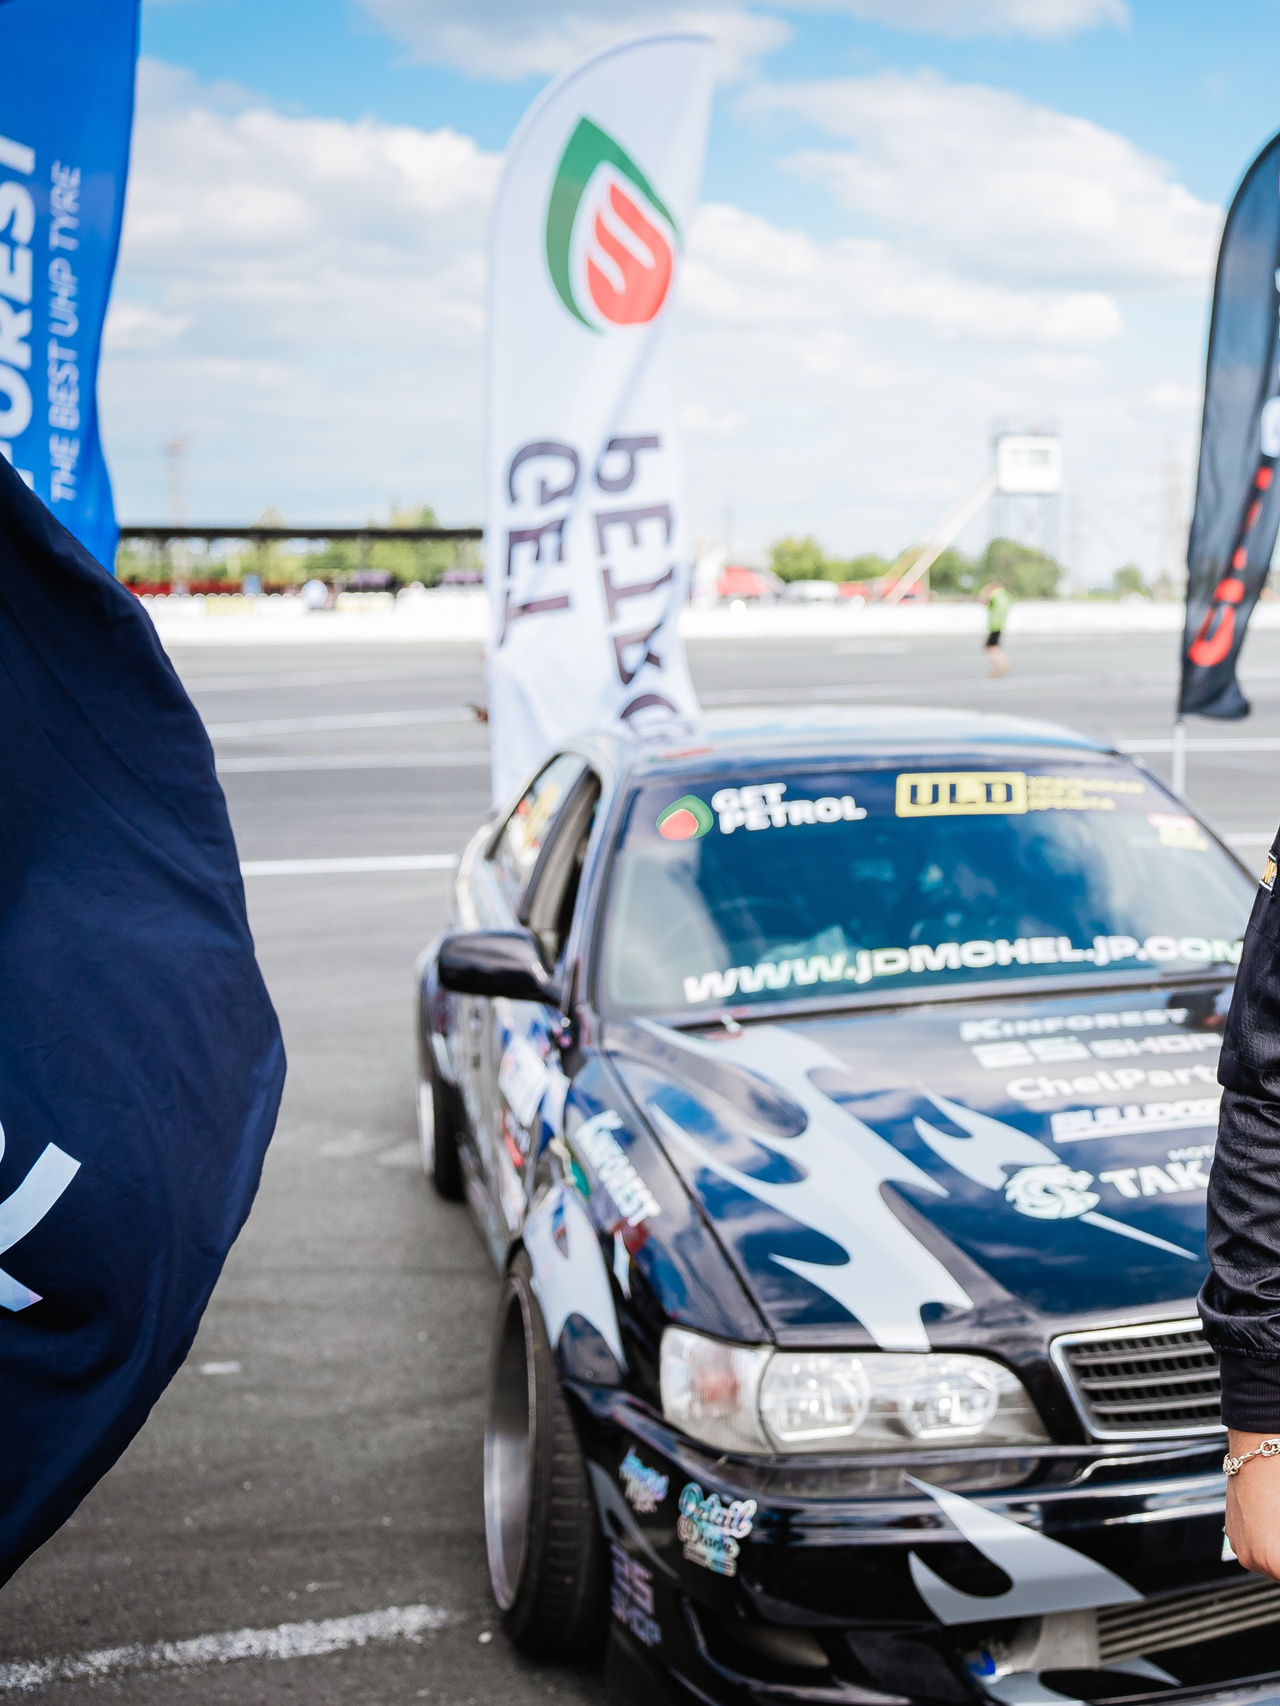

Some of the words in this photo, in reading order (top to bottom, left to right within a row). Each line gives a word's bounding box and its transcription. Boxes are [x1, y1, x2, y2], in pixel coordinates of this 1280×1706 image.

[49, 159, 81, 251] TYRE
[48, 256, 79, 338] UHP
[47, 338, 80, 432] BEST
[50, 432, 80, 502] THE
[711, 782, 788, 814] GET
[718, 795, 868, 835] PETROL
[1005, 1064, 1218, 1101] ChelPart
